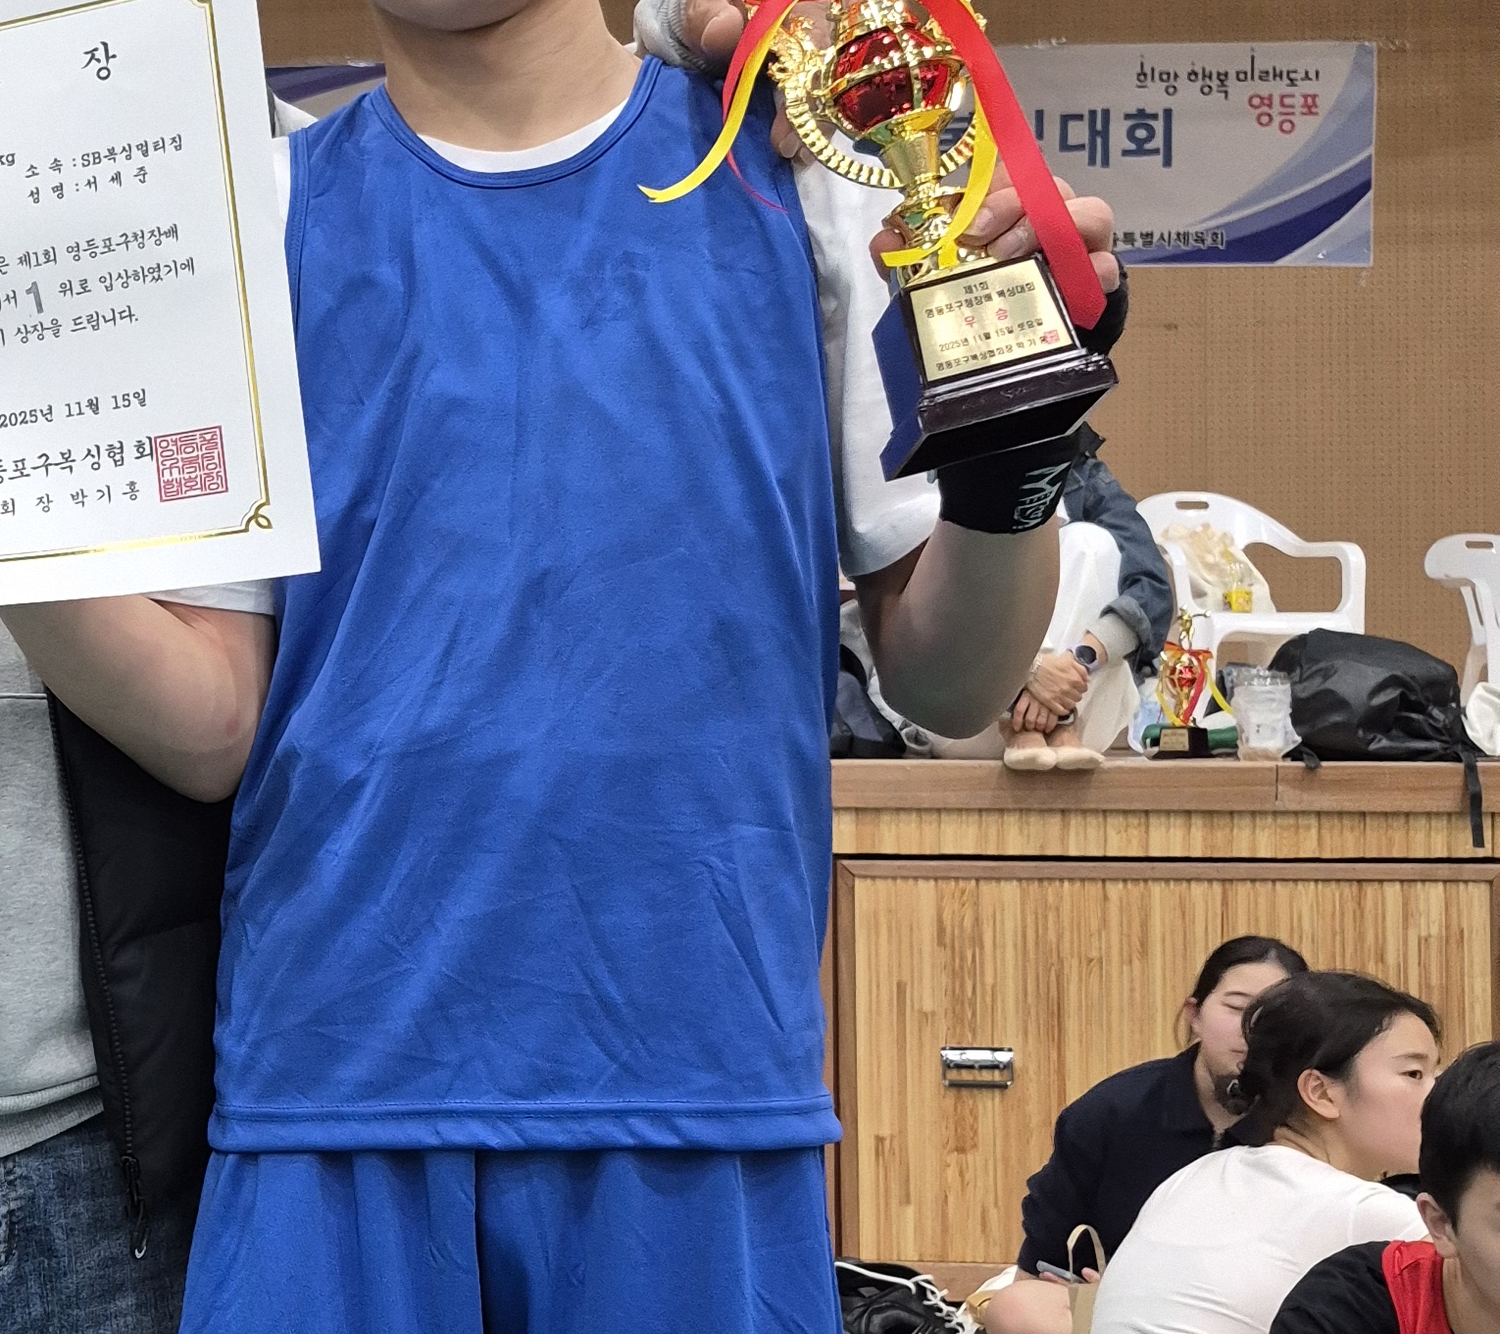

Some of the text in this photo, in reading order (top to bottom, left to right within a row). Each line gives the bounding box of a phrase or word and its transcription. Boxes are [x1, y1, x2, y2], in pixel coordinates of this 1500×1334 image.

[1135, 54, 1180, 96] 희망
[1187, 61, 1230, 101] 행복
[1247, 93, 1320, 135] 영등포
[16, 246, 58, 269] 제1회
[65, 223, 180, 262] 영등포구청장배
[58, 278, 93, 298] 위로
[98, 257, 196, 292] 입상하였기에
[963, 281, 989, 295] 제1회
[924, 281, 1036, 318] 영등포구청장배 복싱대회
[14, 317, 63, 344] 상장을
[70, 305, 139, 333] 드립니다.
[938, 318, 1044, 352] 2025년 11월 15일 토요일
[64, 396, 100, 418] 11월
[111, 388, 147, 410] 15일
